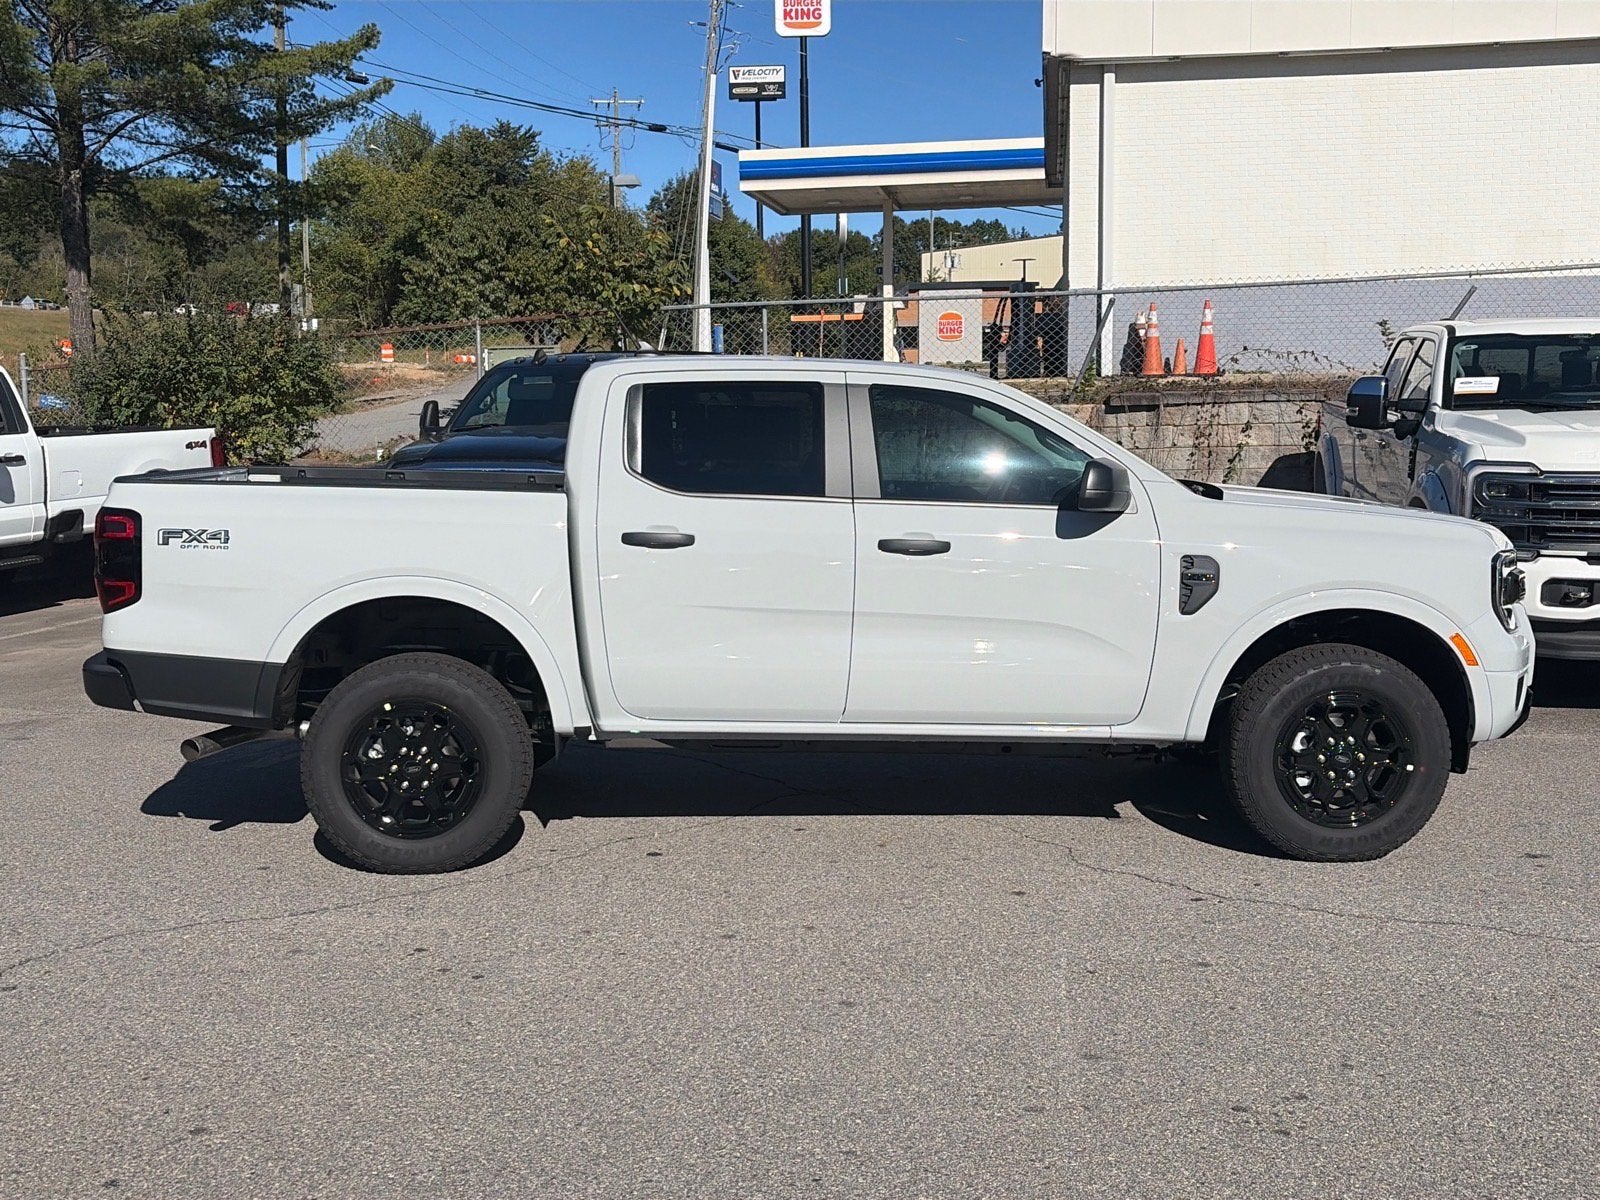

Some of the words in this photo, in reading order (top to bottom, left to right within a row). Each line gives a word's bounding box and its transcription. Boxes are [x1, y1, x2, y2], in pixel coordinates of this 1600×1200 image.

[783, 8, 822, 20] KING
[741, 68, 782, 76] VELOCITY
[938, 327, 963, 335] KING
[157, 528, 230, 545] FX4
